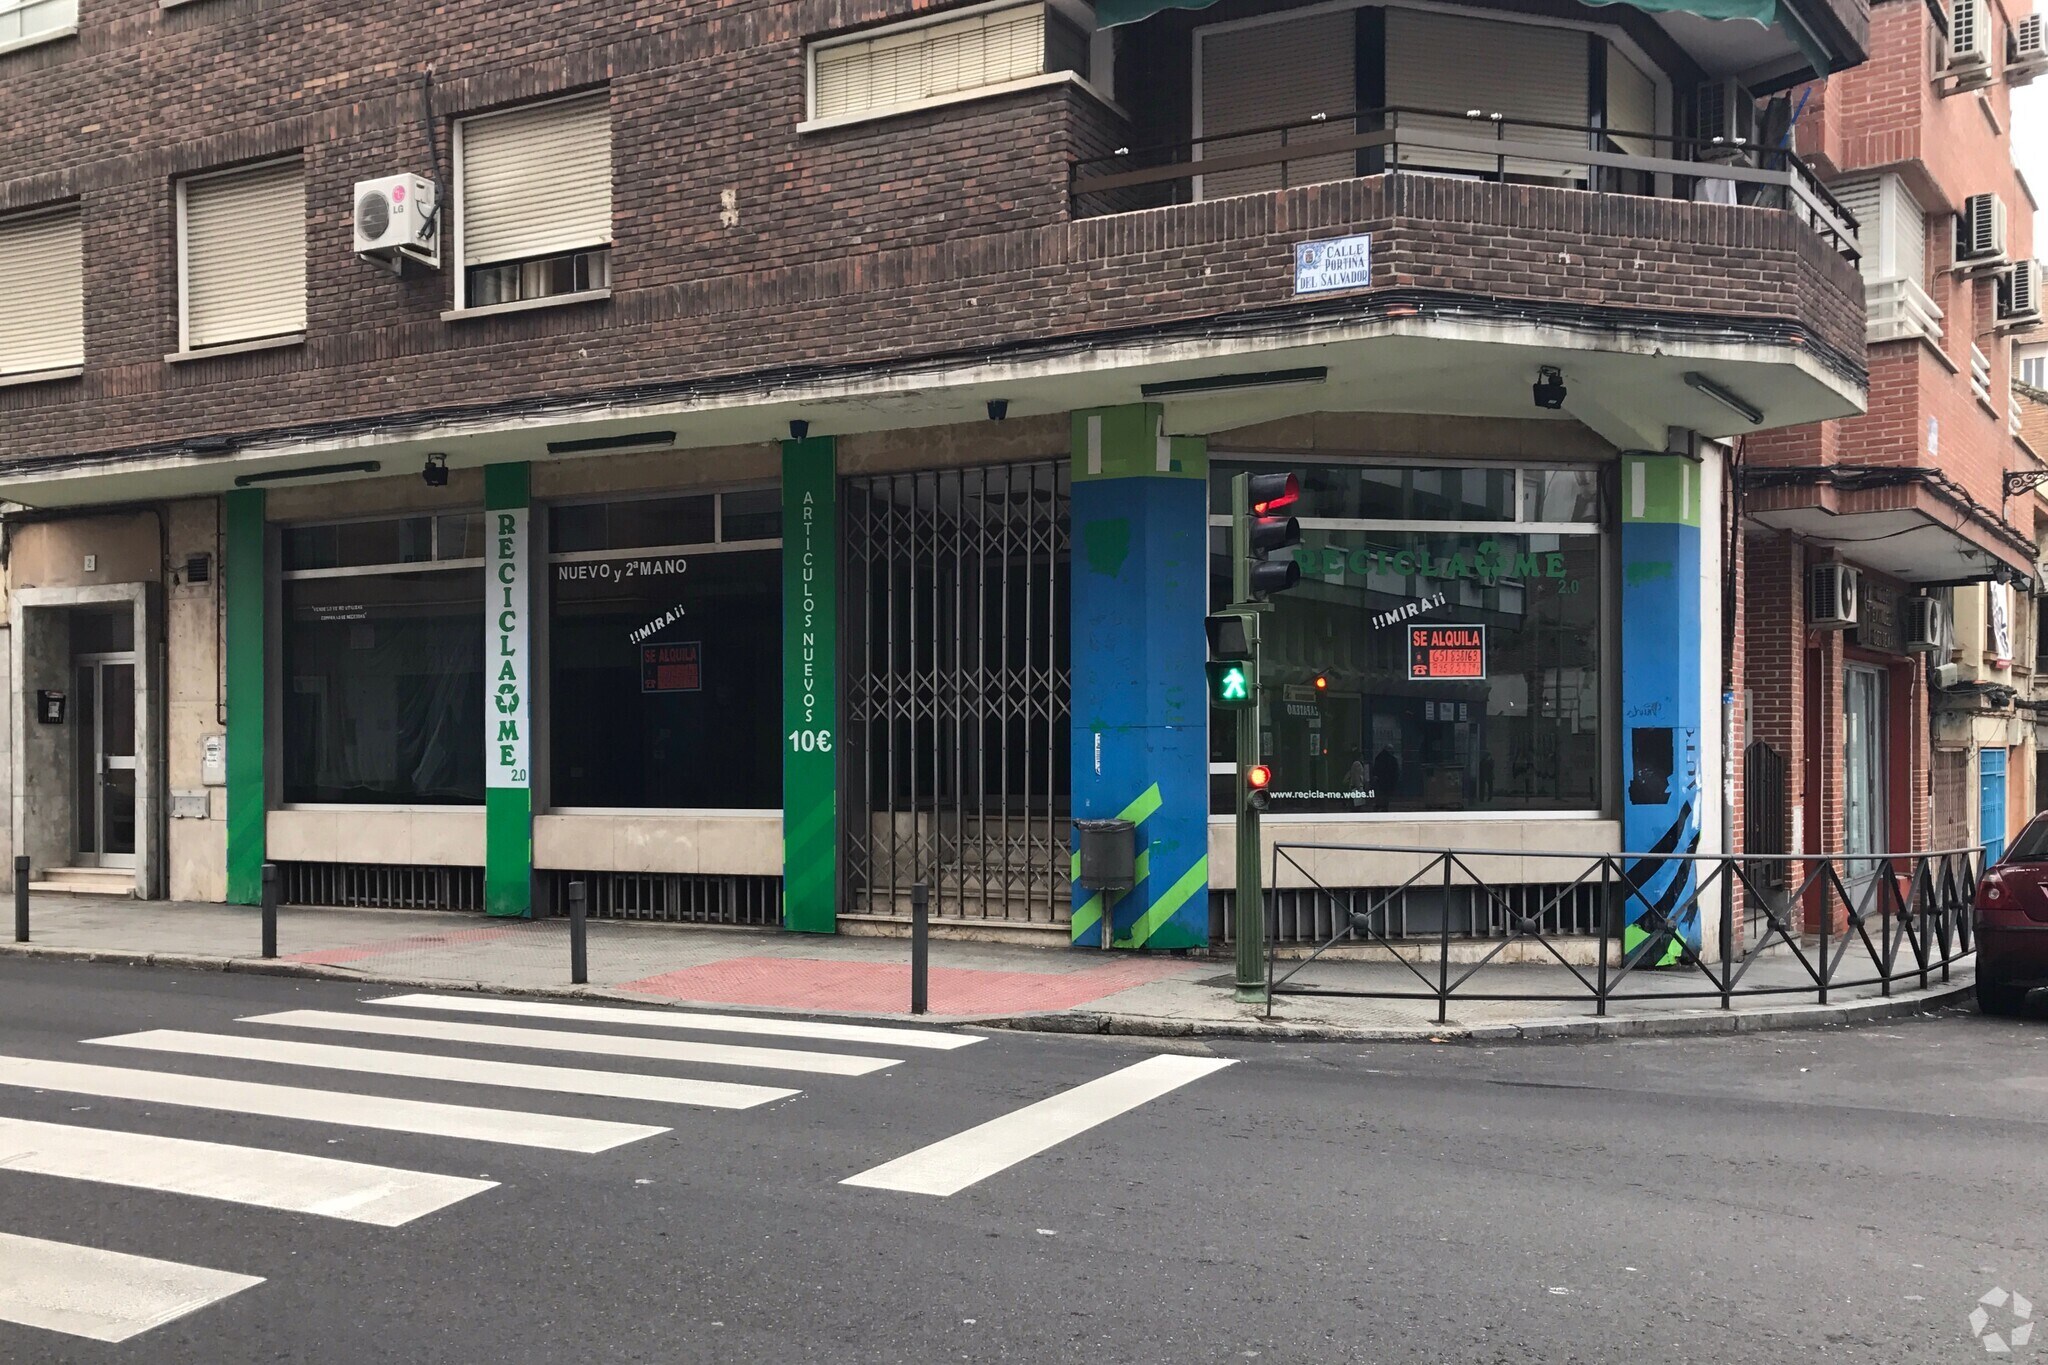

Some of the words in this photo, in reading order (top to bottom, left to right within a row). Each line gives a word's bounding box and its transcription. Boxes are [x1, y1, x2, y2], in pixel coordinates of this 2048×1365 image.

[393, 205, 404, 214] LG
[1326, 243, 1364, 258] CALLE
[1300, 276, 1318, 289] DEL
[1320, 270, 1368, 287] SALVADOR
[87, 558, 92, 568] 2
[803, 491, 814, 627] ARTICULOS
[558, 564, 610, 580] NUEVO
[614, 569, 622, 583] y
[1558, 579, 1580, 594] 2.0
[1413, 631, 1427, 647] SE
[1431, 630, 1480, 648] ALQUILA
[644, 649, 657, 663] SE
[658, 647, 697, 663] ALQUILA
[803, 633, 815, 722] NUEVOS
[788, 730, 832, 752] 10€
[511, 769, 526, 781] 2.0
